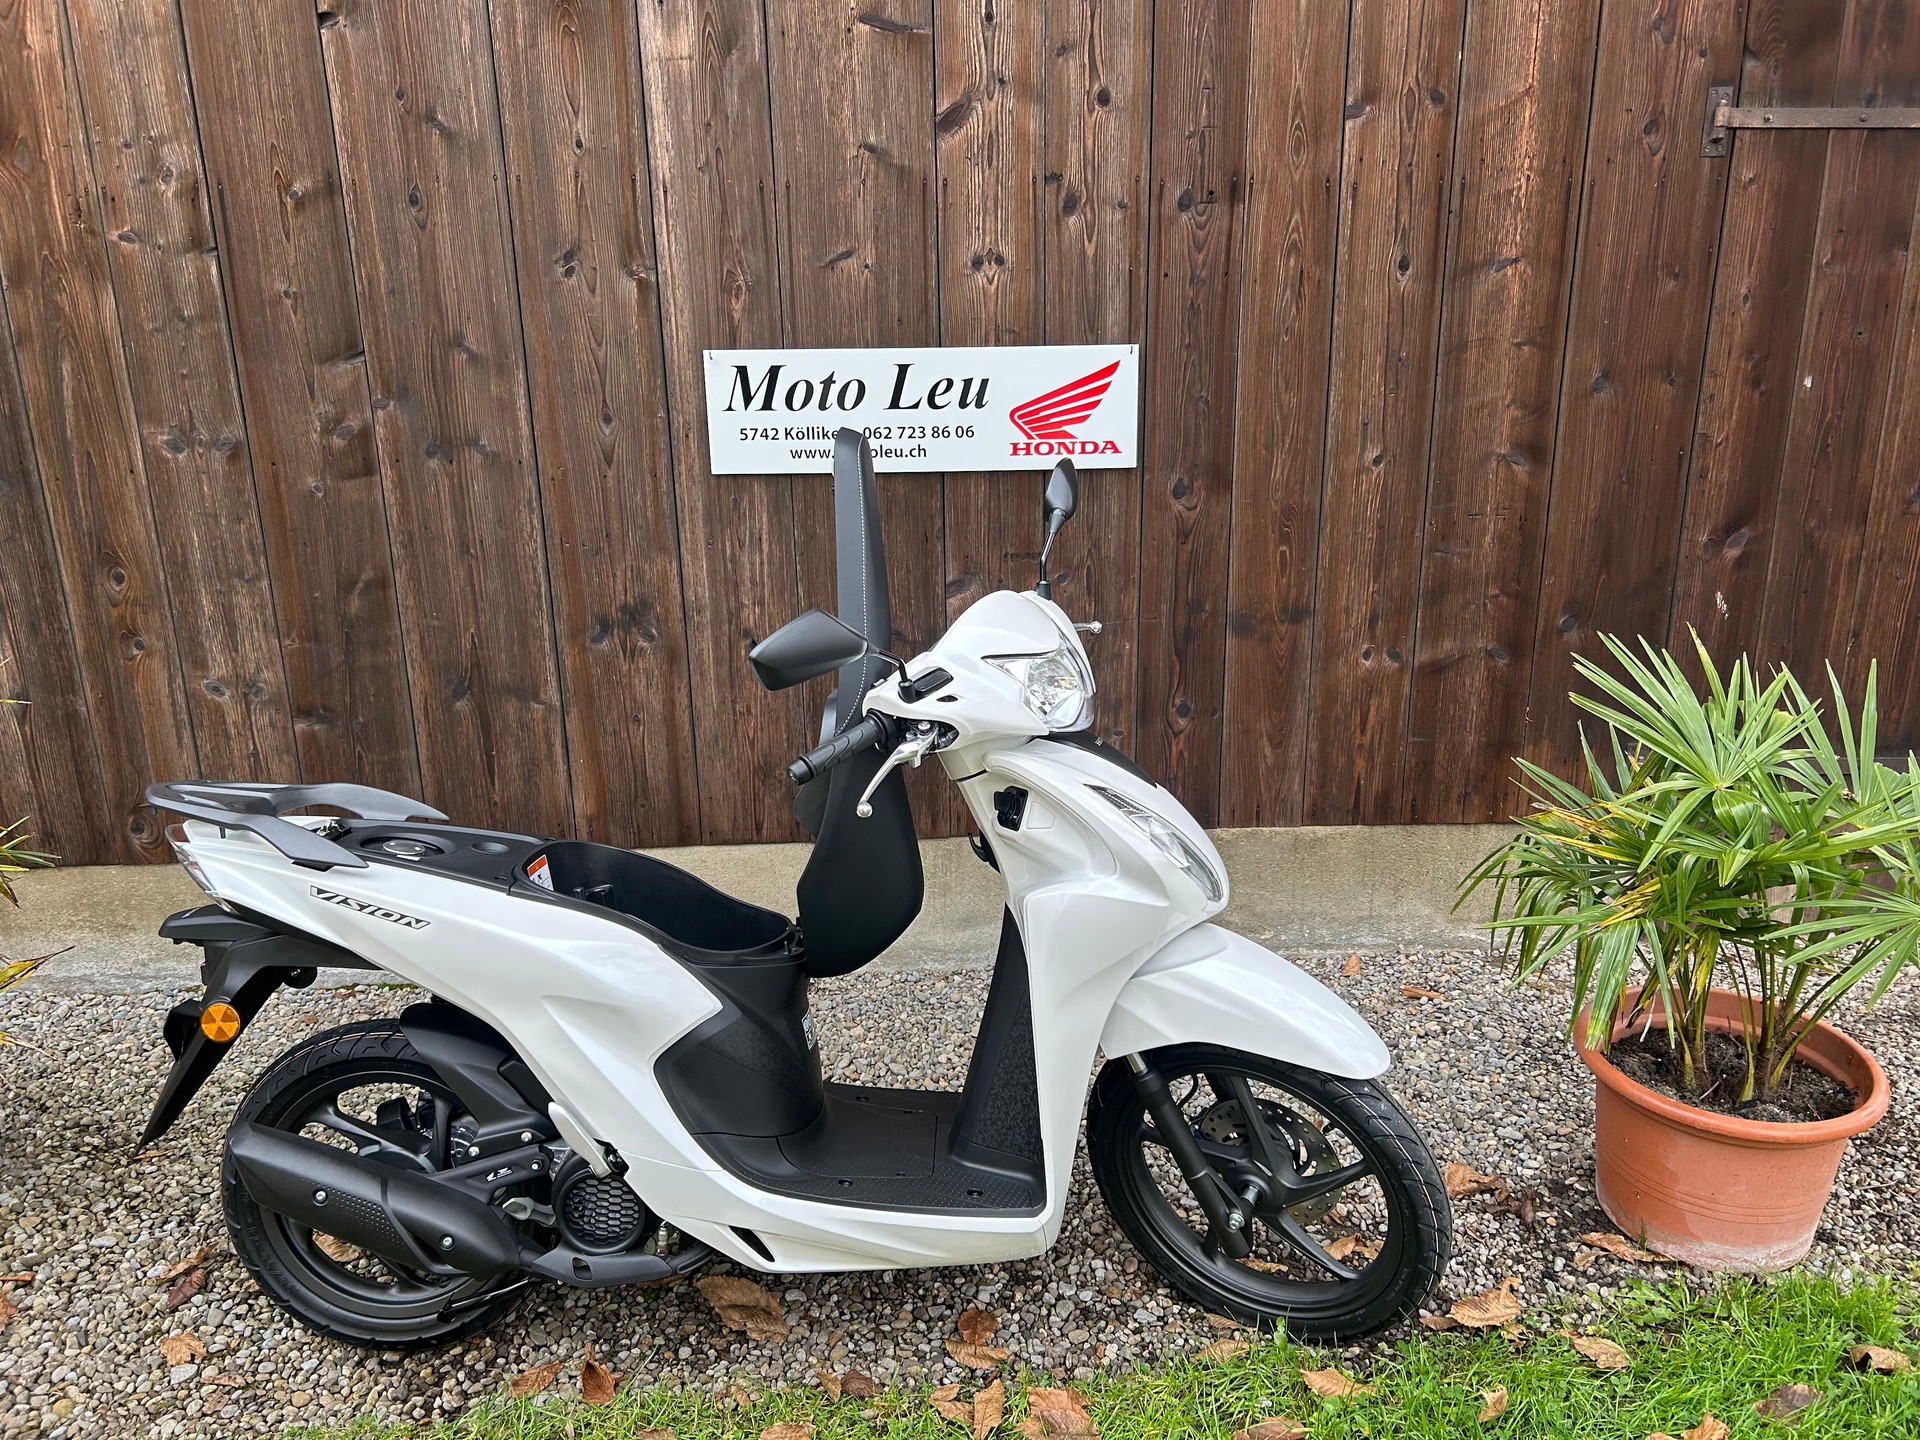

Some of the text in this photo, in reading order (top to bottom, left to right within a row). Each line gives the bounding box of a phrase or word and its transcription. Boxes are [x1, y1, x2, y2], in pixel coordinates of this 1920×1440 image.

[723, 363, 990, 412] Moto Leu
[739, 425, 975, 441] 5742 Köllike 062 723 86 06
[789, 443, 927, 460] www.oleu.ch
[1009, 440, 1122, 456] HONDA
[310, 885, 431, 930] VISION
